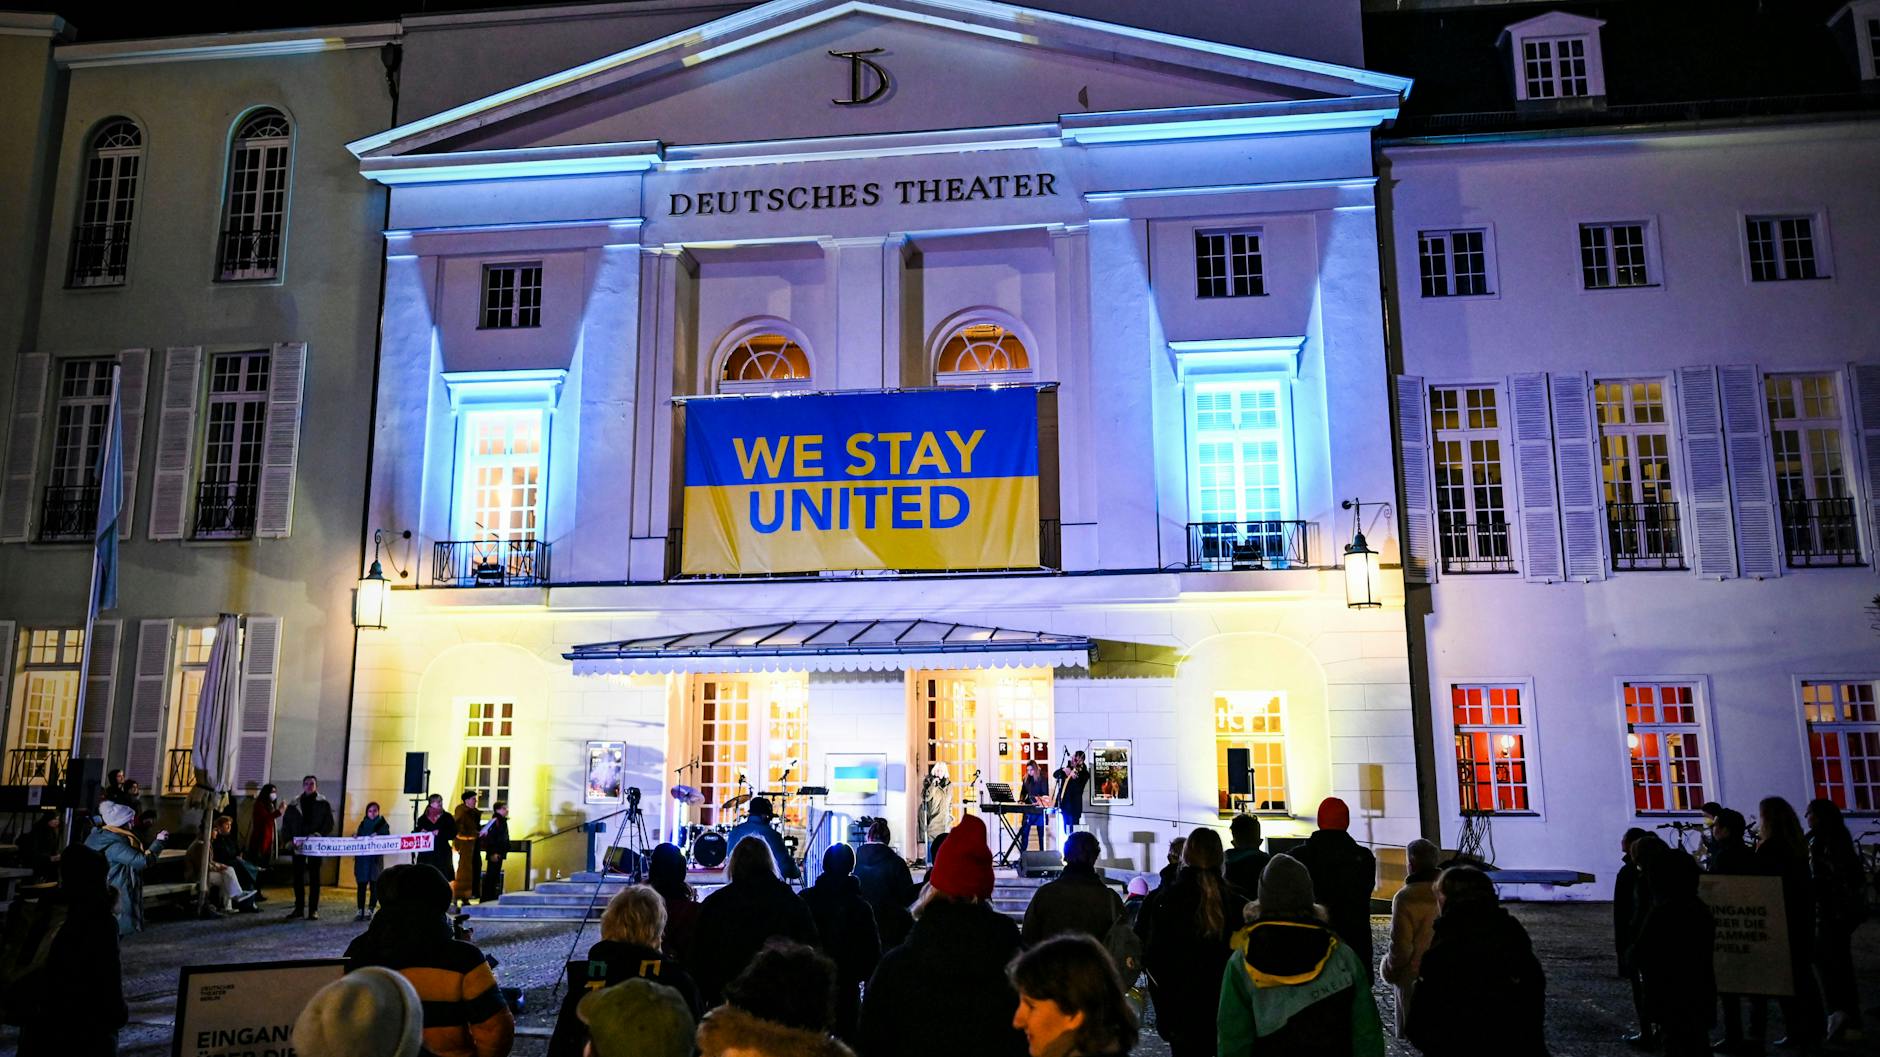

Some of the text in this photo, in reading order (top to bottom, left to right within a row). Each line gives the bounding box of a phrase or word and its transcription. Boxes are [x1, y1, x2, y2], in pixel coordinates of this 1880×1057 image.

[669, 173, 1058, 216] DEUTSCHES THEATER
[732, 429, 986, 479] WE STAY
[749, 485, 970, 534] UNITED
